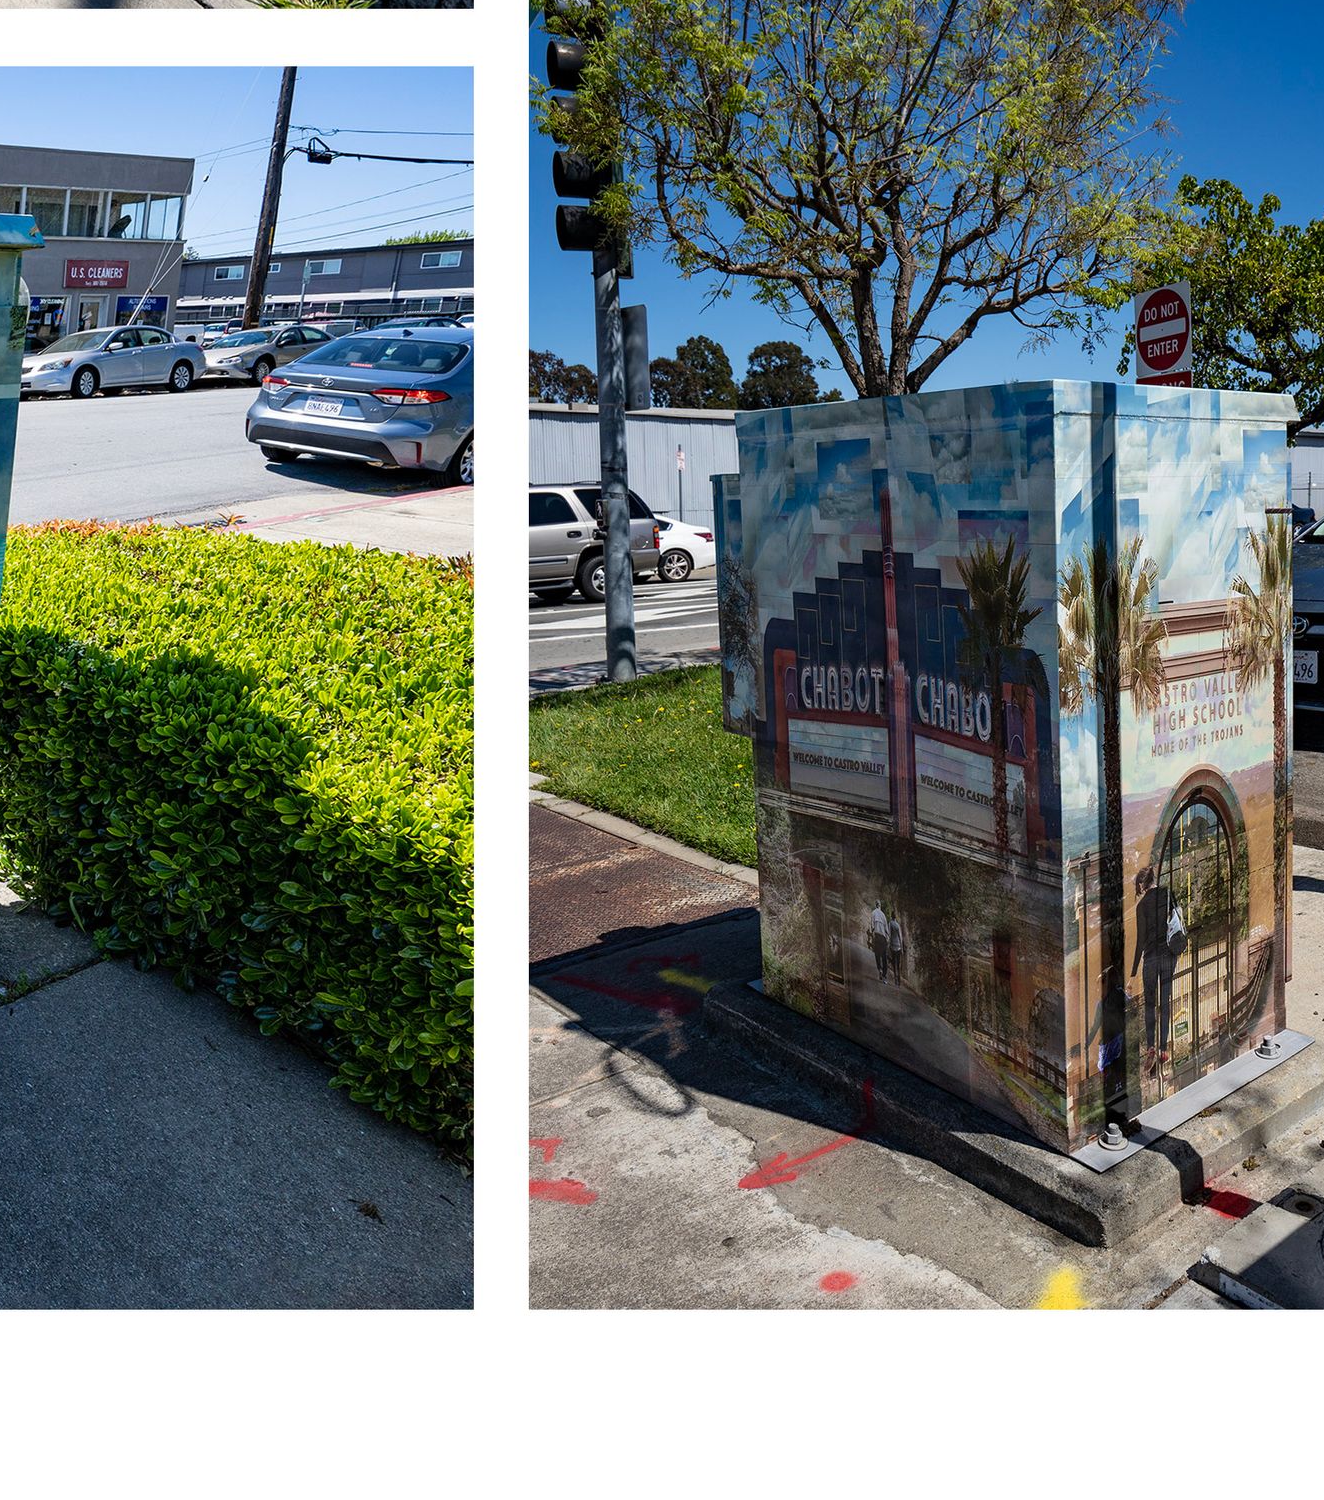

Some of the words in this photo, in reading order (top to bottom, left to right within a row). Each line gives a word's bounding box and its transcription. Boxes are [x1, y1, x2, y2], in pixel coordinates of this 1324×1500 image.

[71, 267, 86, 278] U.S.
[87, 267, 124, 279] CLEANERS
[1144, 307, 1157, 323] DO
[1160, 301, 1180, 318] NOT
[1147, 339, 1179, 358] ENTER
[800, 664, 885, 716] CHABOT
[1203, 671, 1242, 698] VALLE
[915, 673, 992, 743] CHABO
[1153, 708, 1187, 736] HIGH
[1192, 696, 1243, 726] SCHOOL
[1151, 742, 1175, 758] HOME
[1178, 739, 1189, 751] OF
[1192, 733, 1207, 748] THE
[1210, 724, 1244, 742] TROJANS
[792, 751, 823, 767] WELCOME
[824, 755, 834, 767] TO
[834, 757, 860, 772] CASTRO
[860, 759, 886, 775] VALLEY
[920, 773, 954, 795] WELCOME
[955, 786, 965, 798] TO
